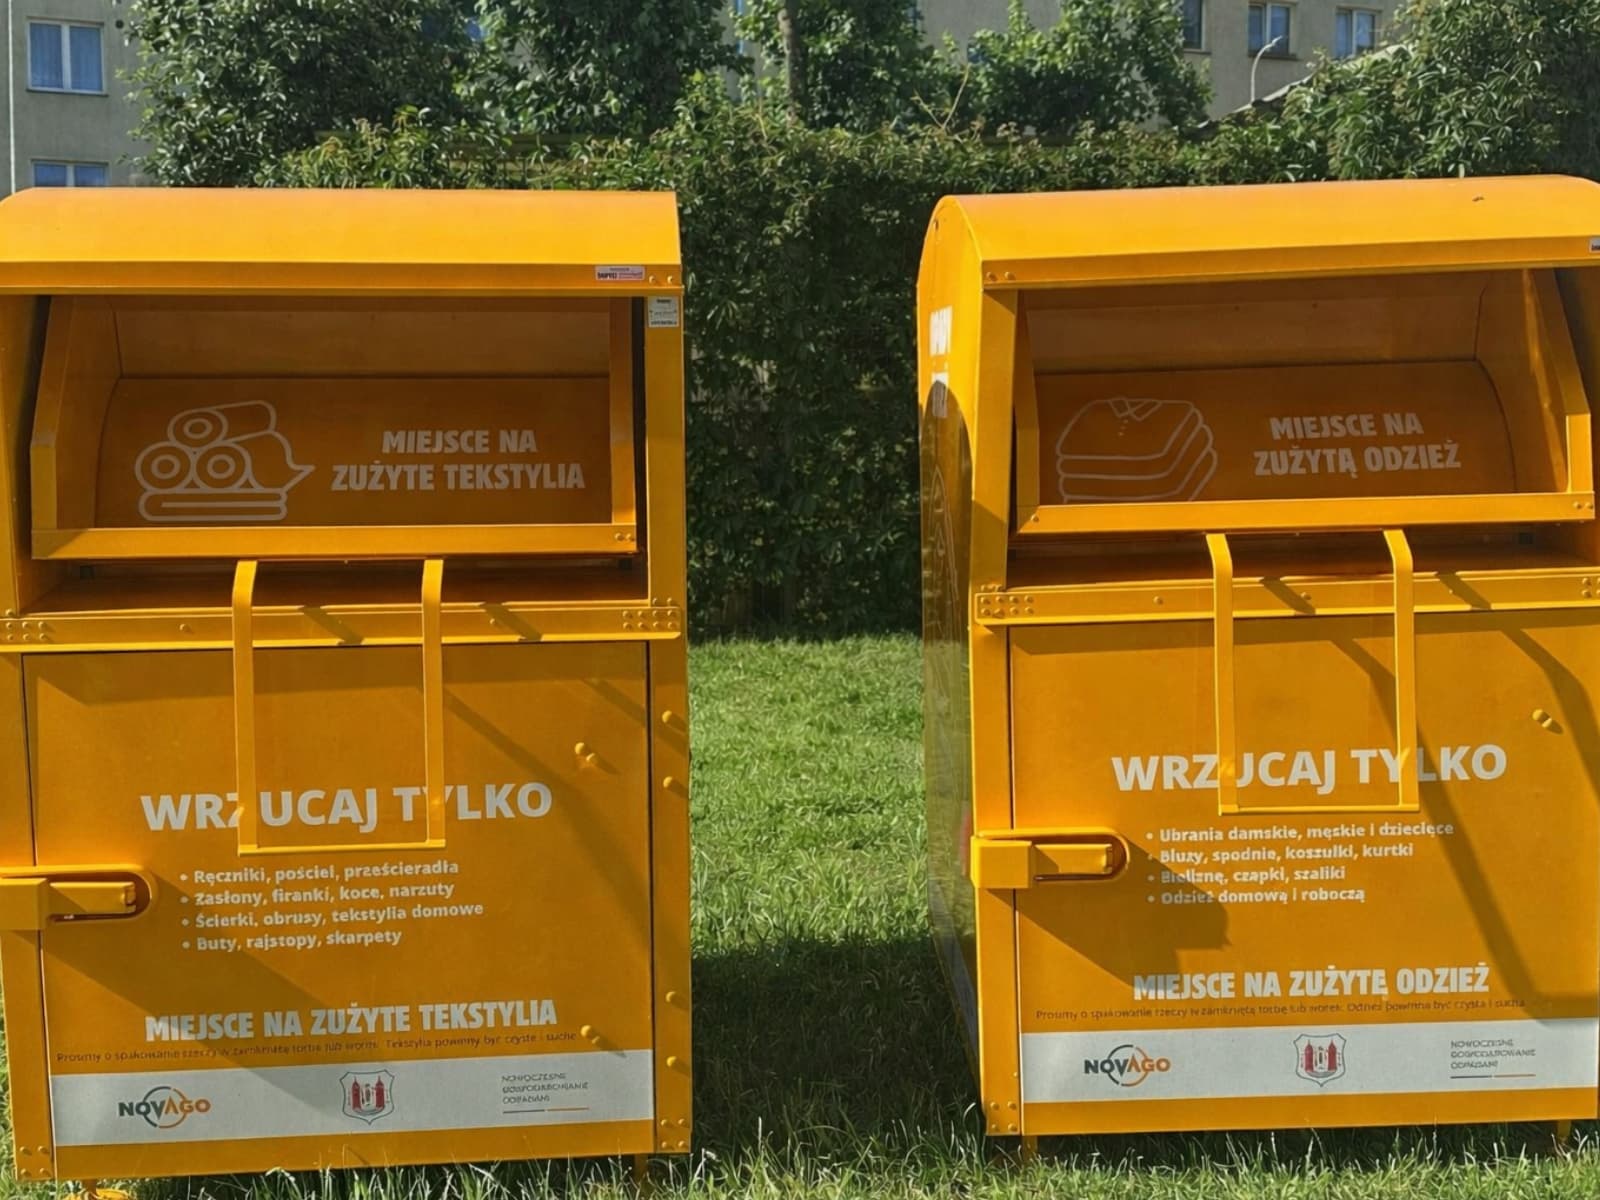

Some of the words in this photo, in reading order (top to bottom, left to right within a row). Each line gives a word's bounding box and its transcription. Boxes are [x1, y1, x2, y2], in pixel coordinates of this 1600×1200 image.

[1269, 414, 1377, 440] MIEJSCE
[1383, 412, 1424, 435] NA
[381, 430, 490, 454] MIEJSCE
[499, 429, 538, 453] NA
[1254, 445, 1358, 479] ZUŻYTĄ
[1364, 440, 1462, 473] ODZIEŻ
[331, 460, 435, 491] ZUŻYTE
[443, 463, 586, 490] TEKSTYLIA
[1350, 744, 1508, 785] TYLKO
[1160, 828, 1223, 842] Ubrania
[1228, 825, 1303, 841] damskie,
[1307, 824, 1365, 840] męskie
[1212, 847, 1281, 863] spodnie,
[1362, 843, 1414, 857] kurtki
[194, 867, 270, 886] Ręczniki,
[344, 860, 459, 881] prześcieradła
[1233, 867, 1289, 884] czapki,
[1294, 866, 1345, 880] szaliki
[272, 886, 334, 903] firanki,
[389, 882, 455, 899] narzuty
[1218, 889, 1288, 905] domową
[263, 911, 326, 928] obrusy,
[332, 906, 407, 924] tekstylia
[412, 904, 484, 919] domowe
[246, 933, 322, 951] rajstopy,
[326, 929, 402, 946] skarpety
[1133, 972, 1235, 1000] MIEJSCE
[1244, 971, 1281, 998] NA
[1396, 962, 1490, 995] ODZIEŻ
[145, 1012, 254, 1041] MIEJSCE
[263, 1011, 303, 1036] NA
[310, 1002, 410, 1036] ZUŻYTE
[418, 999, 557, 1030] TEKSTYLIA
[1084, 1052, 1171, 1077] NOVAGO
[118, 1096, 211, 1121] NOVAGO
